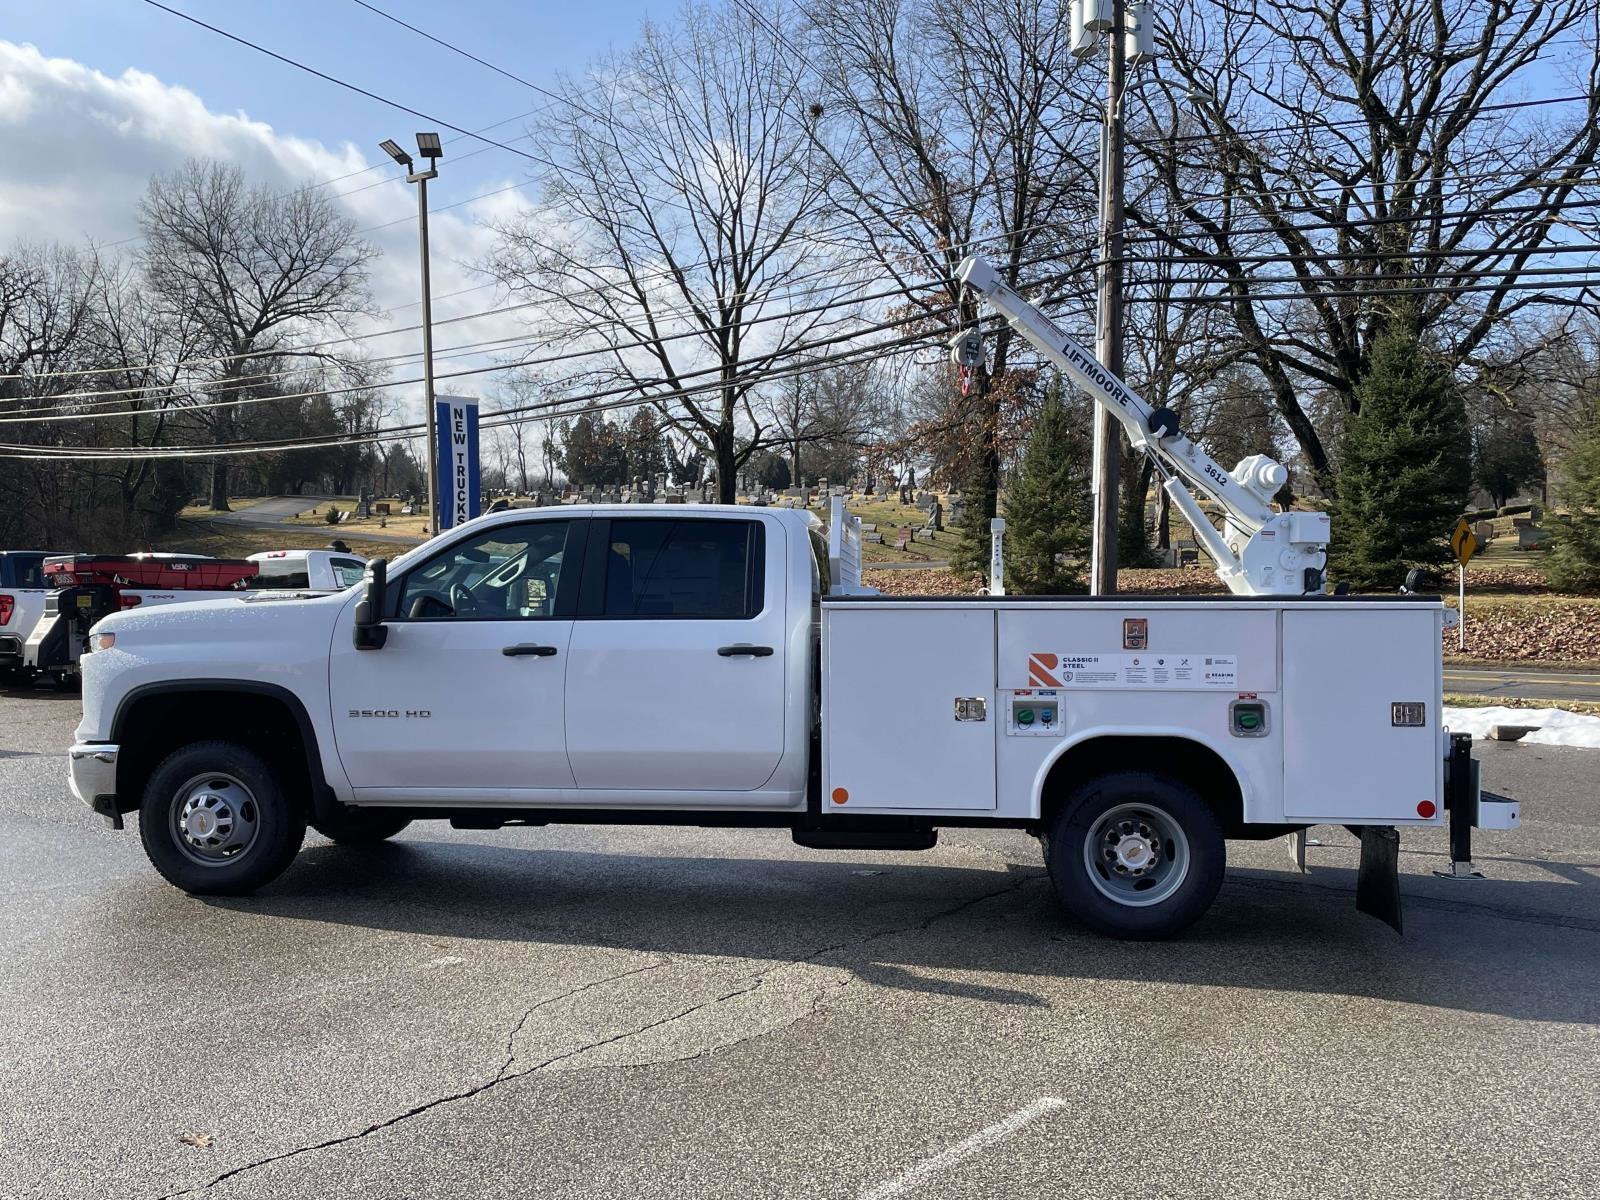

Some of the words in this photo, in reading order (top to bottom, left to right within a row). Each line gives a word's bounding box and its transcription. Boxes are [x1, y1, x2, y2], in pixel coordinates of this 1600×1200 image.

[1062, 343, 1131, 407] LIFTMOORE
[453, 408, 466, 445] NEW
[457, 453, 466, 526] TRUCKS
[1204, 464, 1227, 487] 3612
[348, 709, 400, 718] 3500
[405, 709, 432, 718] HD
